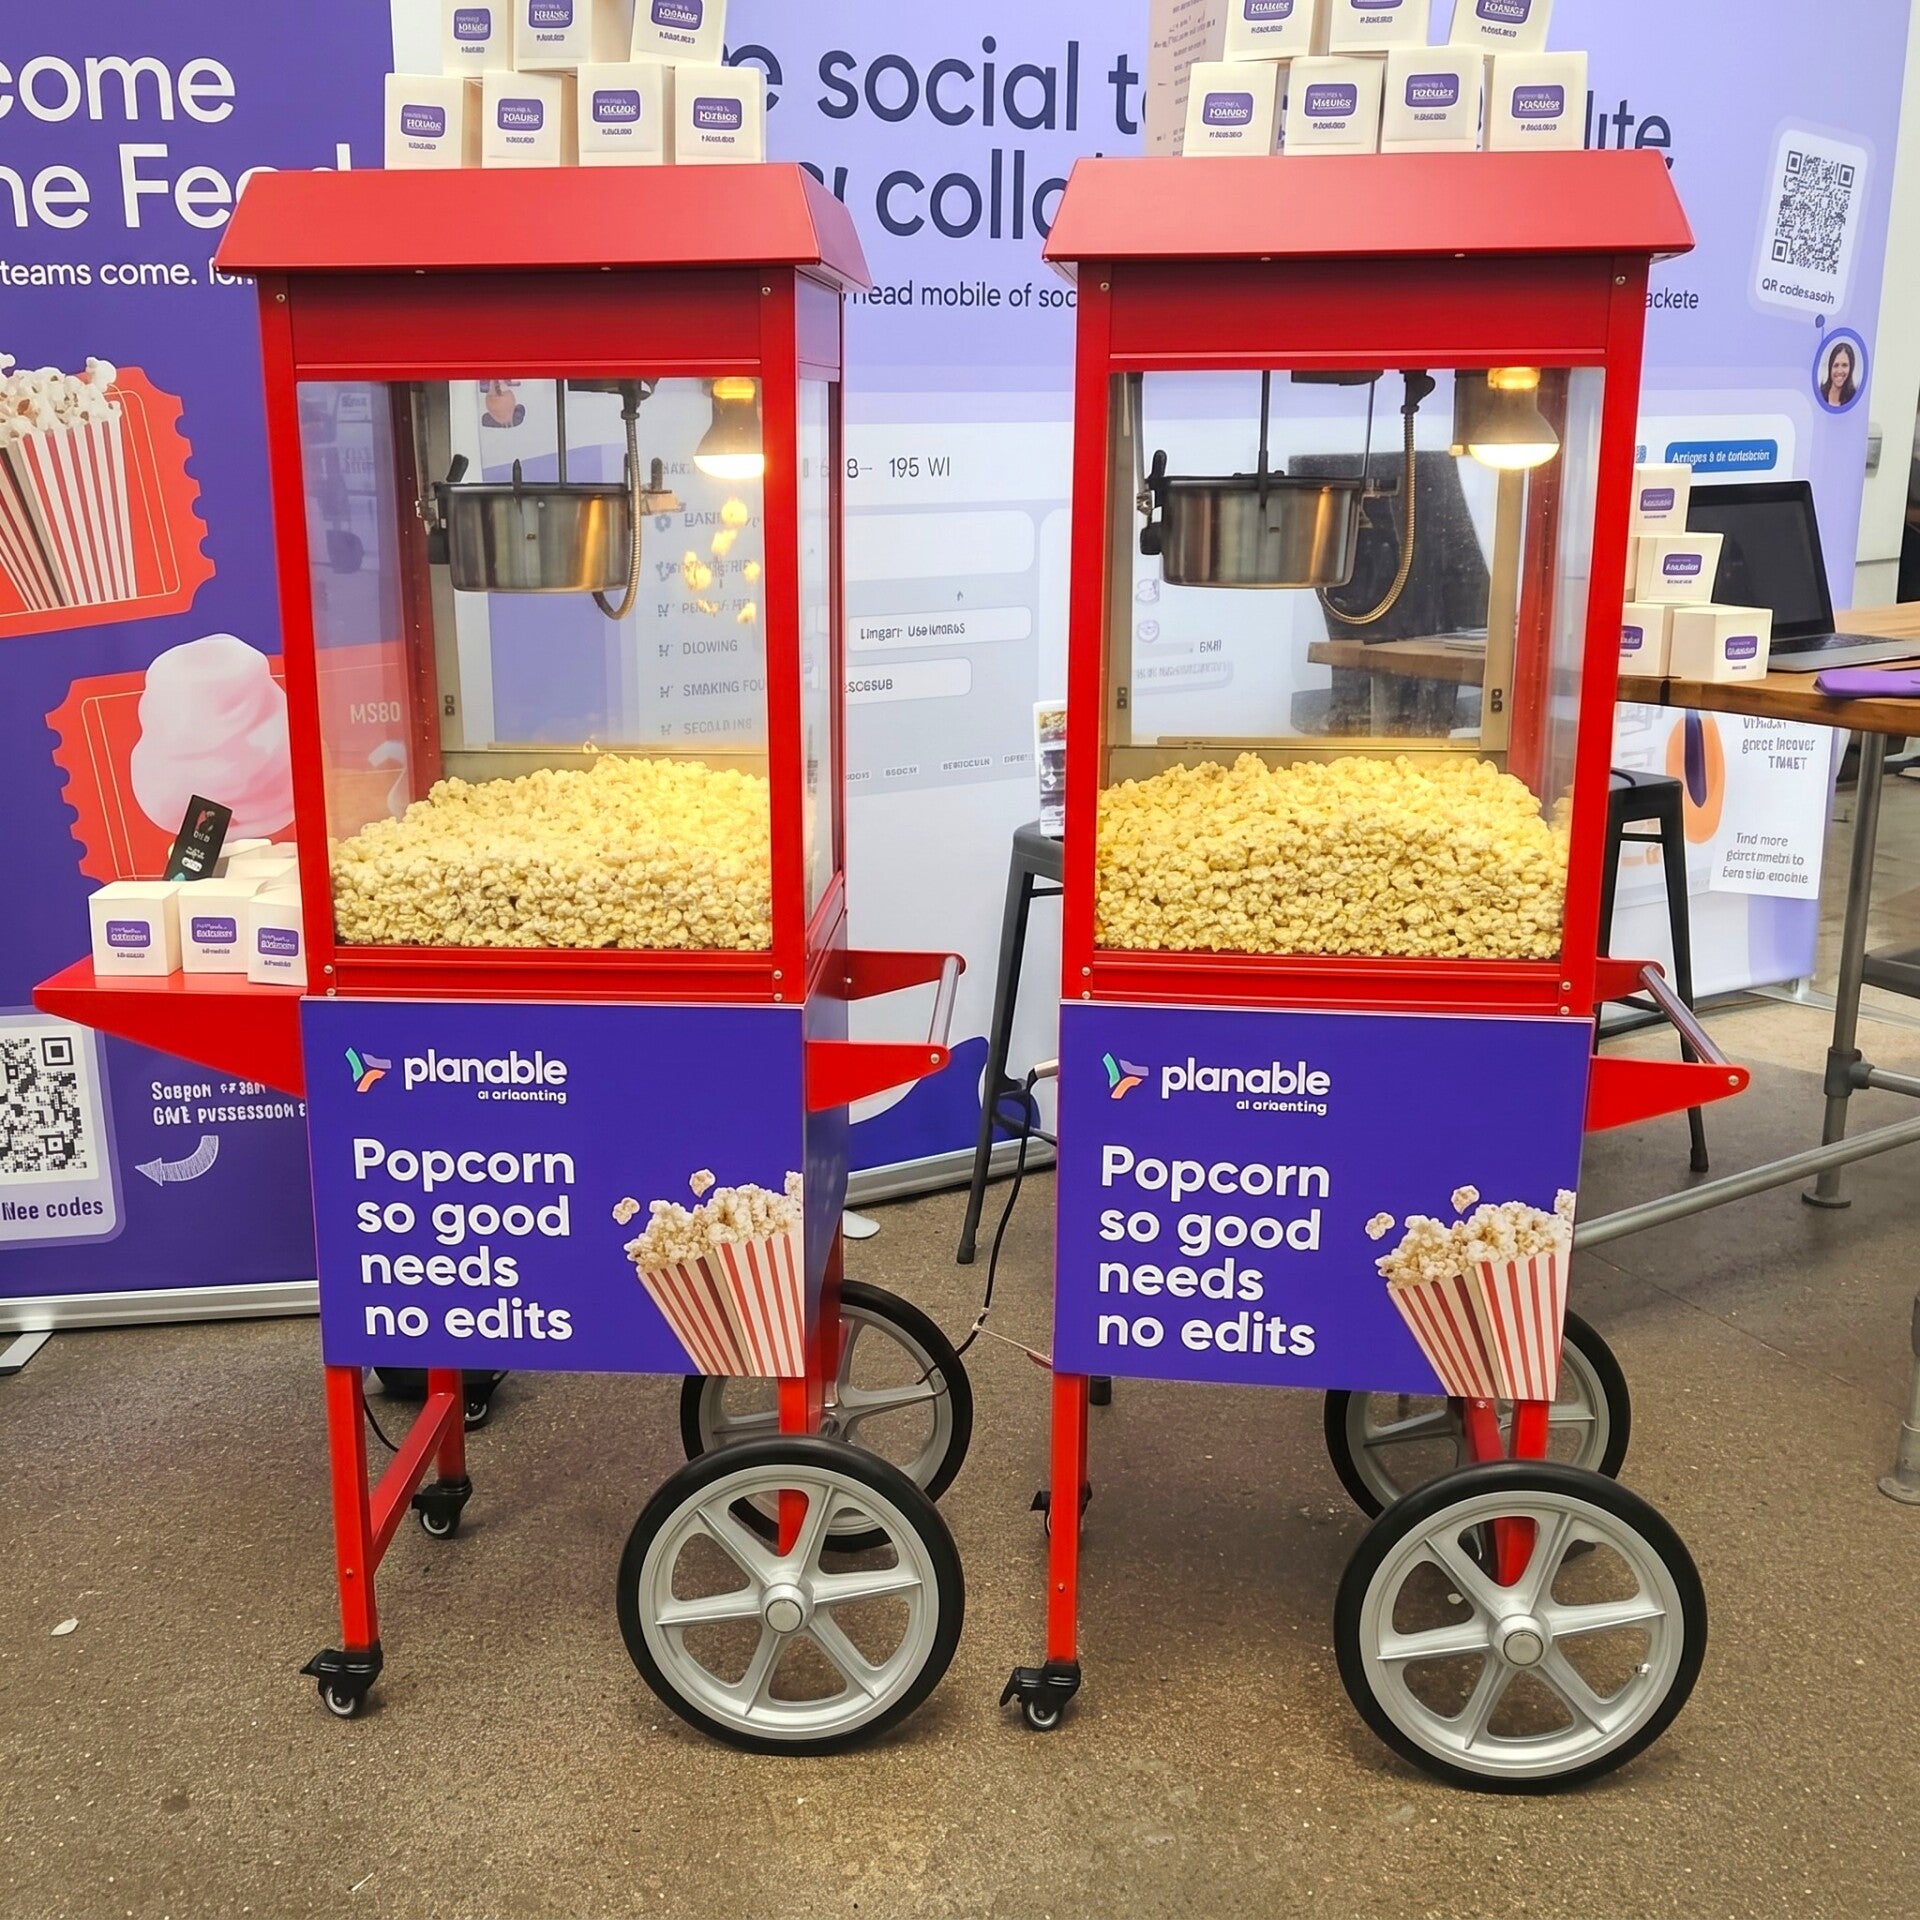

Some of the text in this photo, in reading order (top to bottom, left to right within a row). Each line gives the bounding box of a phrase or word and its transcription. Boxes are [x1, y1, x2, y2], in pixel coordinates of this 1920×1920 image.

[817, 35, 1079, 132] social
[0, 262, 91, 285] teams
[100, 264, 198, 285] come.
[921, 281, 1001, 306] mobile
[1008, 282, 1033, 307] of
[1762, 278, 1778, 291] QR
[888, 457, 920, 478] 195
[404, 1049, 567, 1090] planable
[1161, 1057, 1331, 1099] planable
[353, 1138, 575, 1192] Popcorn
[1101, 1145, 1330, 1202] Popcorn
[46, 1196, 104, 1218] codes
[356, 1195, 571, 1245] so good
[1098, 1209, 1321, 1257] so good
[361, 1246, 519, 1287] needs
[1098, 1258, 1264, 1301] needs
[365, 1298, 574, 1341] no edits
[1098, 1311, 1316, 1357] no edits
